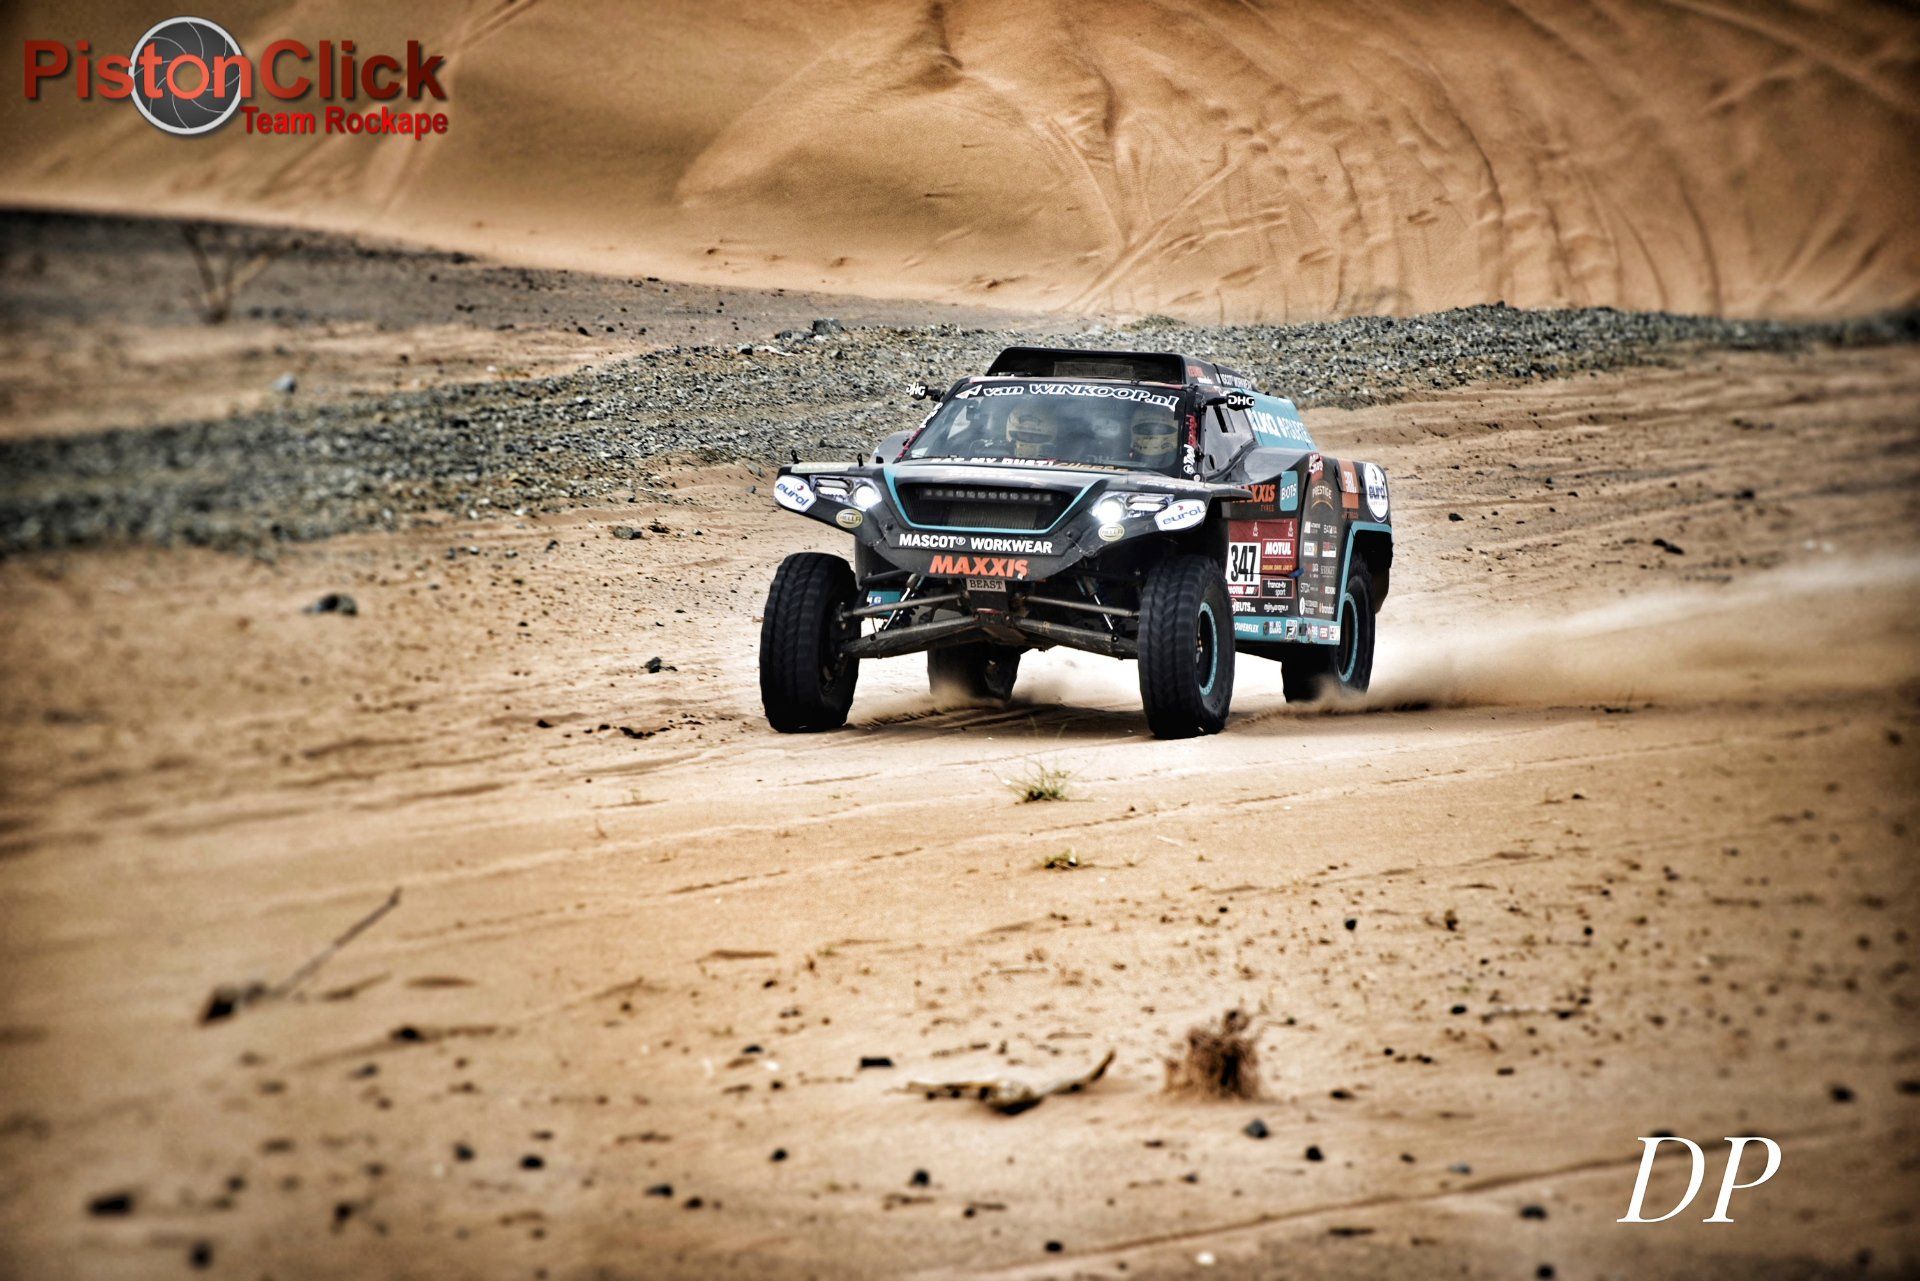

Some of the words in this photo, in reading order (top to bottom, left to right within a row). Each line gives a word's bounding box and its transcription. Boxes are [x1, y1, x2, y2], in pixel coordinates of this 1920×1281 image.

[982, 386, 1024, 397] van
[1029, 383, 1178, 410] WINKOOP.nl
[1227, 394, 1255, 407] DHG
[776, 482, 810, 507] eurol
[1161, 505, 1206, 526] eurol
[970, 537, 1053, 554] WORKWEAR
[1264, 541, 1292, 556] MOTUL
[928, 554, 1029, 579] MAXXIS
[1230, 544, 1257, 582] 347
[969, 578, 1004, 590] BEAST
[1234, 622, 1259, 633] OWERFLEX
